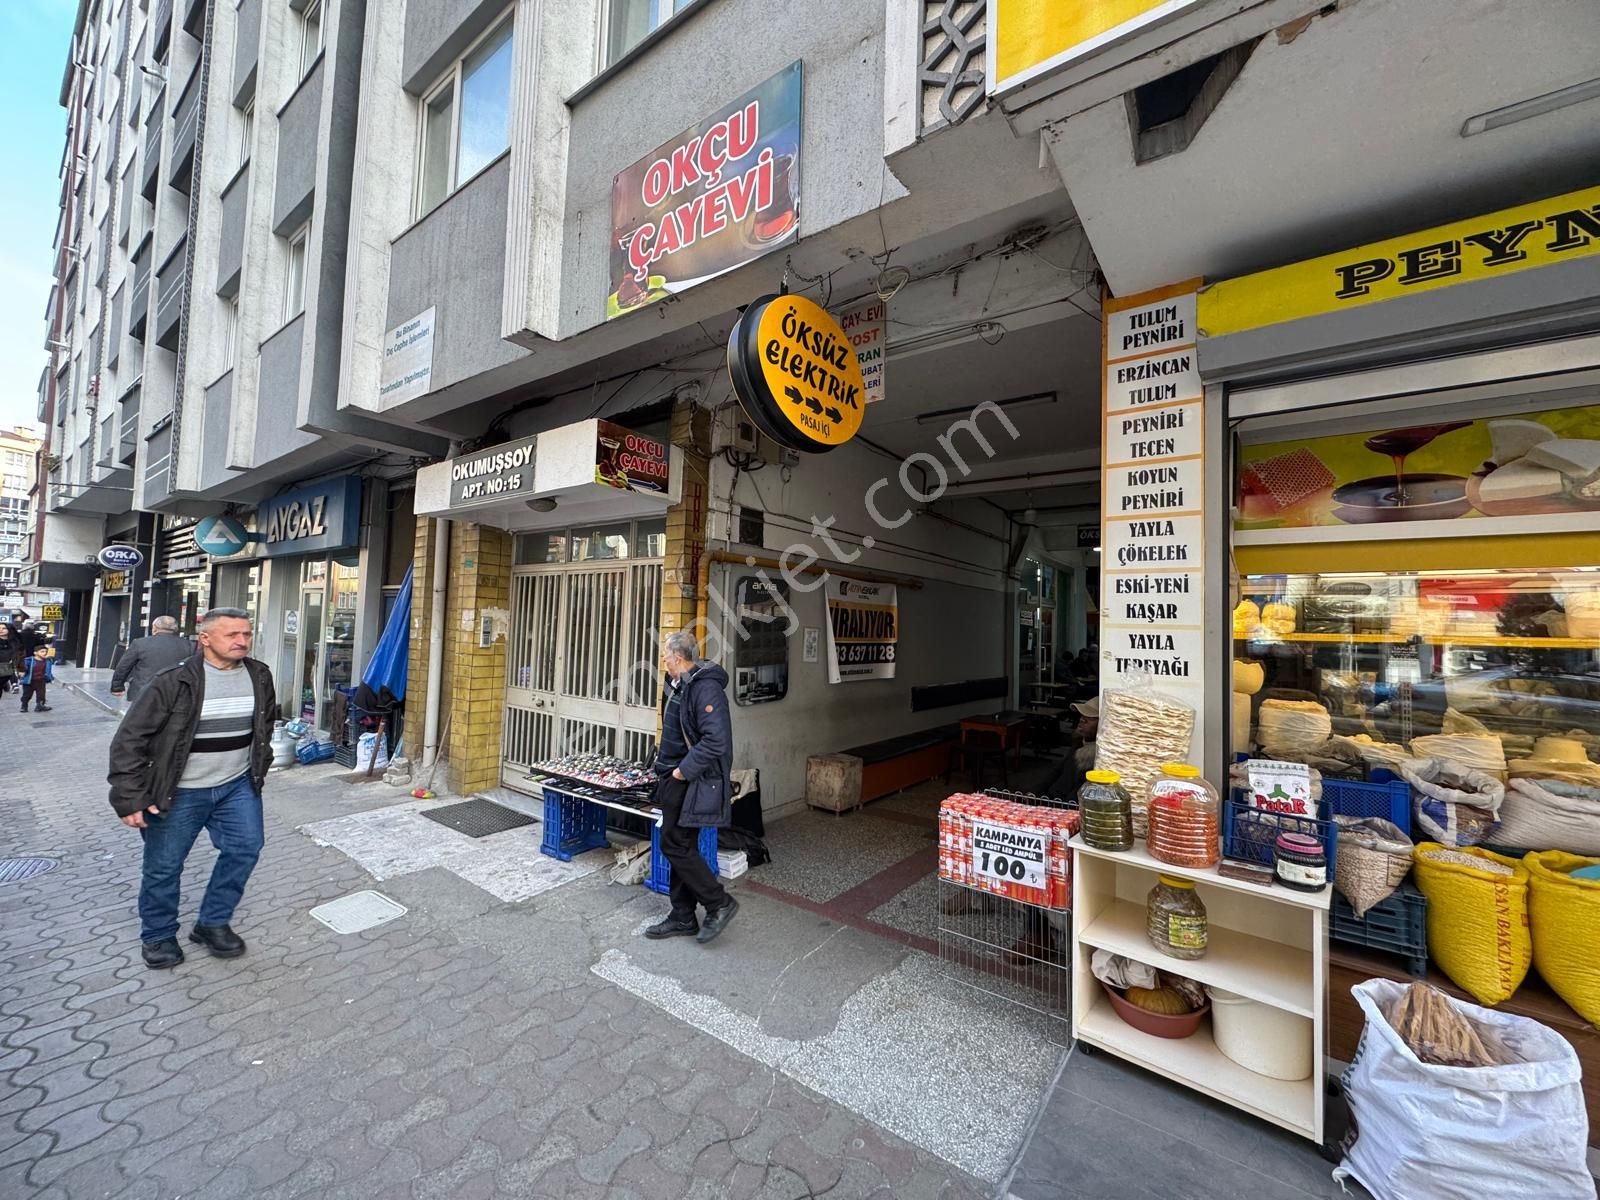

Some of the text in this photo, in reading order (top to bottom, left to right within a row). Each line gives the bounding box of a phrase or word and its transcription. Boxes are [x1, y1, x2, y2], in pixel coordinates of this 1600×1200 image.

[642, 100, 759, 188] OKÇU
[628, 147, 774, 282] ÇAYEVİ
[841, 312, 862, 333] ÇAY
[1129, 305, 1177, 330] TULUM
[781, 306, 849, 371] ÖKSÜZ
[1122, 320, 1184, 351] PEYNİRİ
[856, 347, 881, 364] RAN
[1117, 356, 1190, 384] ERZİNCAN
[1129, 383, 1177, 405] TULUM
[800, 413, 831, 438] PASAJ İÇİ
[1122, 408, 1184, 436] PEYNİRİ
[625, 434, 664, 460] OKÇU
[1130, 438, 1175, 459] TECEN
[452, 444, 534, 481] OKUMUŞSOY
[620, 453, 667, 478] ÇAYEVİ
[461, 473, 521, 500] APT. NO:15
[1127, 466, 1178, 487] KOYUN
[1121, 487, 1184, 511] PEYNİRİ
[267, 495, 326, 544] AYGAZ
[1128, 520, 1175, 538] YAYLA
[1117, 543, 1188, 567] ÇÖKELEK
[1115, 573, 1189, 594] ESKİ-YENİ
[1126, 603, 1178, 623] KAŞAR
[848, 645, 866, 662] 637
[879, 645, 895, 661] 28
[1128, 633, 1175, 651] YAYLA
[975, 826, 1042, 851] KAMPANYA
[985, 842, 1001, 852] ADET
[1002, 846, 1013, 854] LED
[981, 852, 1026, 881] 100
